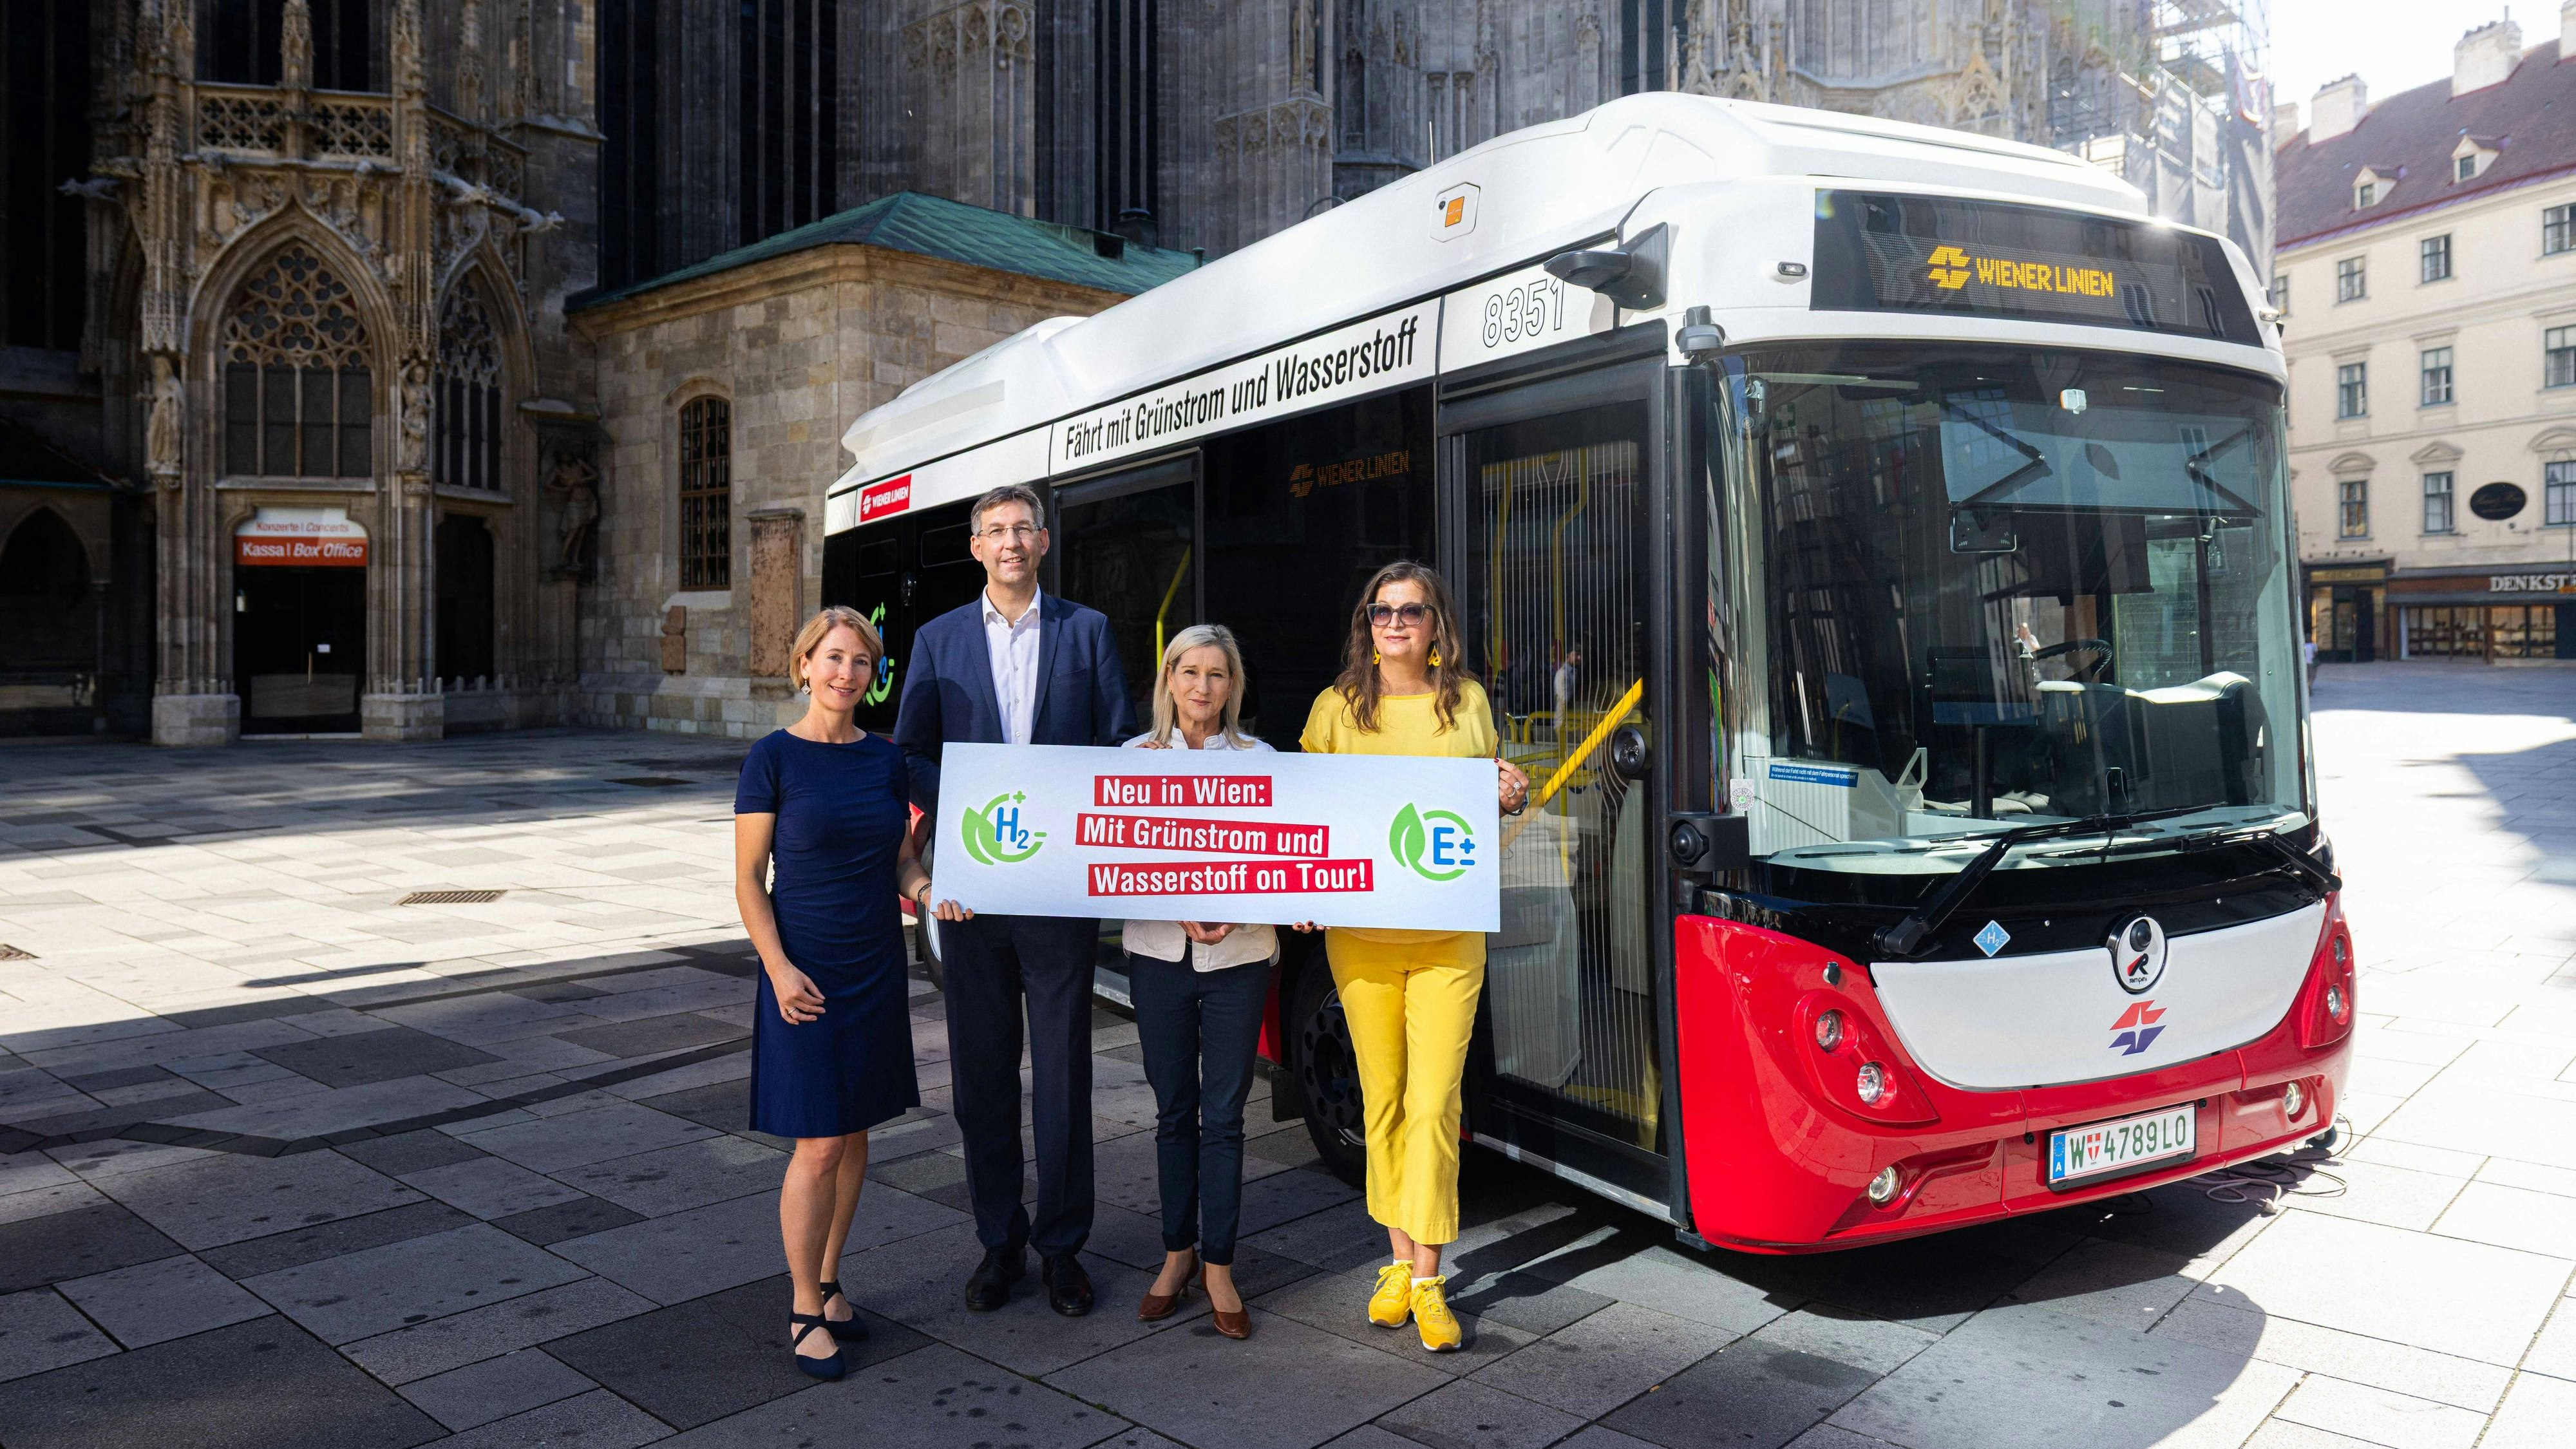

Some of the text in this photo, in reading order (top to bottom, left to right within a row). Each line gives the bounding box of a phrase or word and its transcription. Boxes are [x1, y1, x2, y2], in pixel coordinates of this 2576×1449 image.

[1976, 258, 2114, 298] WIENER LINIEN
[1482, 278, 1564, 348] 8351
[1066, 315, 1418, 460] Fährt mit Grünstrom und Wasserstoff
[1317, 450, 1410, 488] WIENER LINIEN
[872, 486, 909, 508] WIENER LINIEN
[256, 522, 299, 531] Konzerte
[306, 522, 348, 532] Concerts
[243, 542, 283, 556] Kassa
[293, 543, 321, 557] Box
[323, 543, 363, 558] Office
[1103, 777, 1265, 804] Neu in Wien:
[1083, 817, 1323, 855] Mit Grünstrom und
[1094, 861, 1367, 894] Wasserstoff on Tour!
[2055, 1161, 2062, 1172] A
[2070, 1135, 2085, 1170] W
